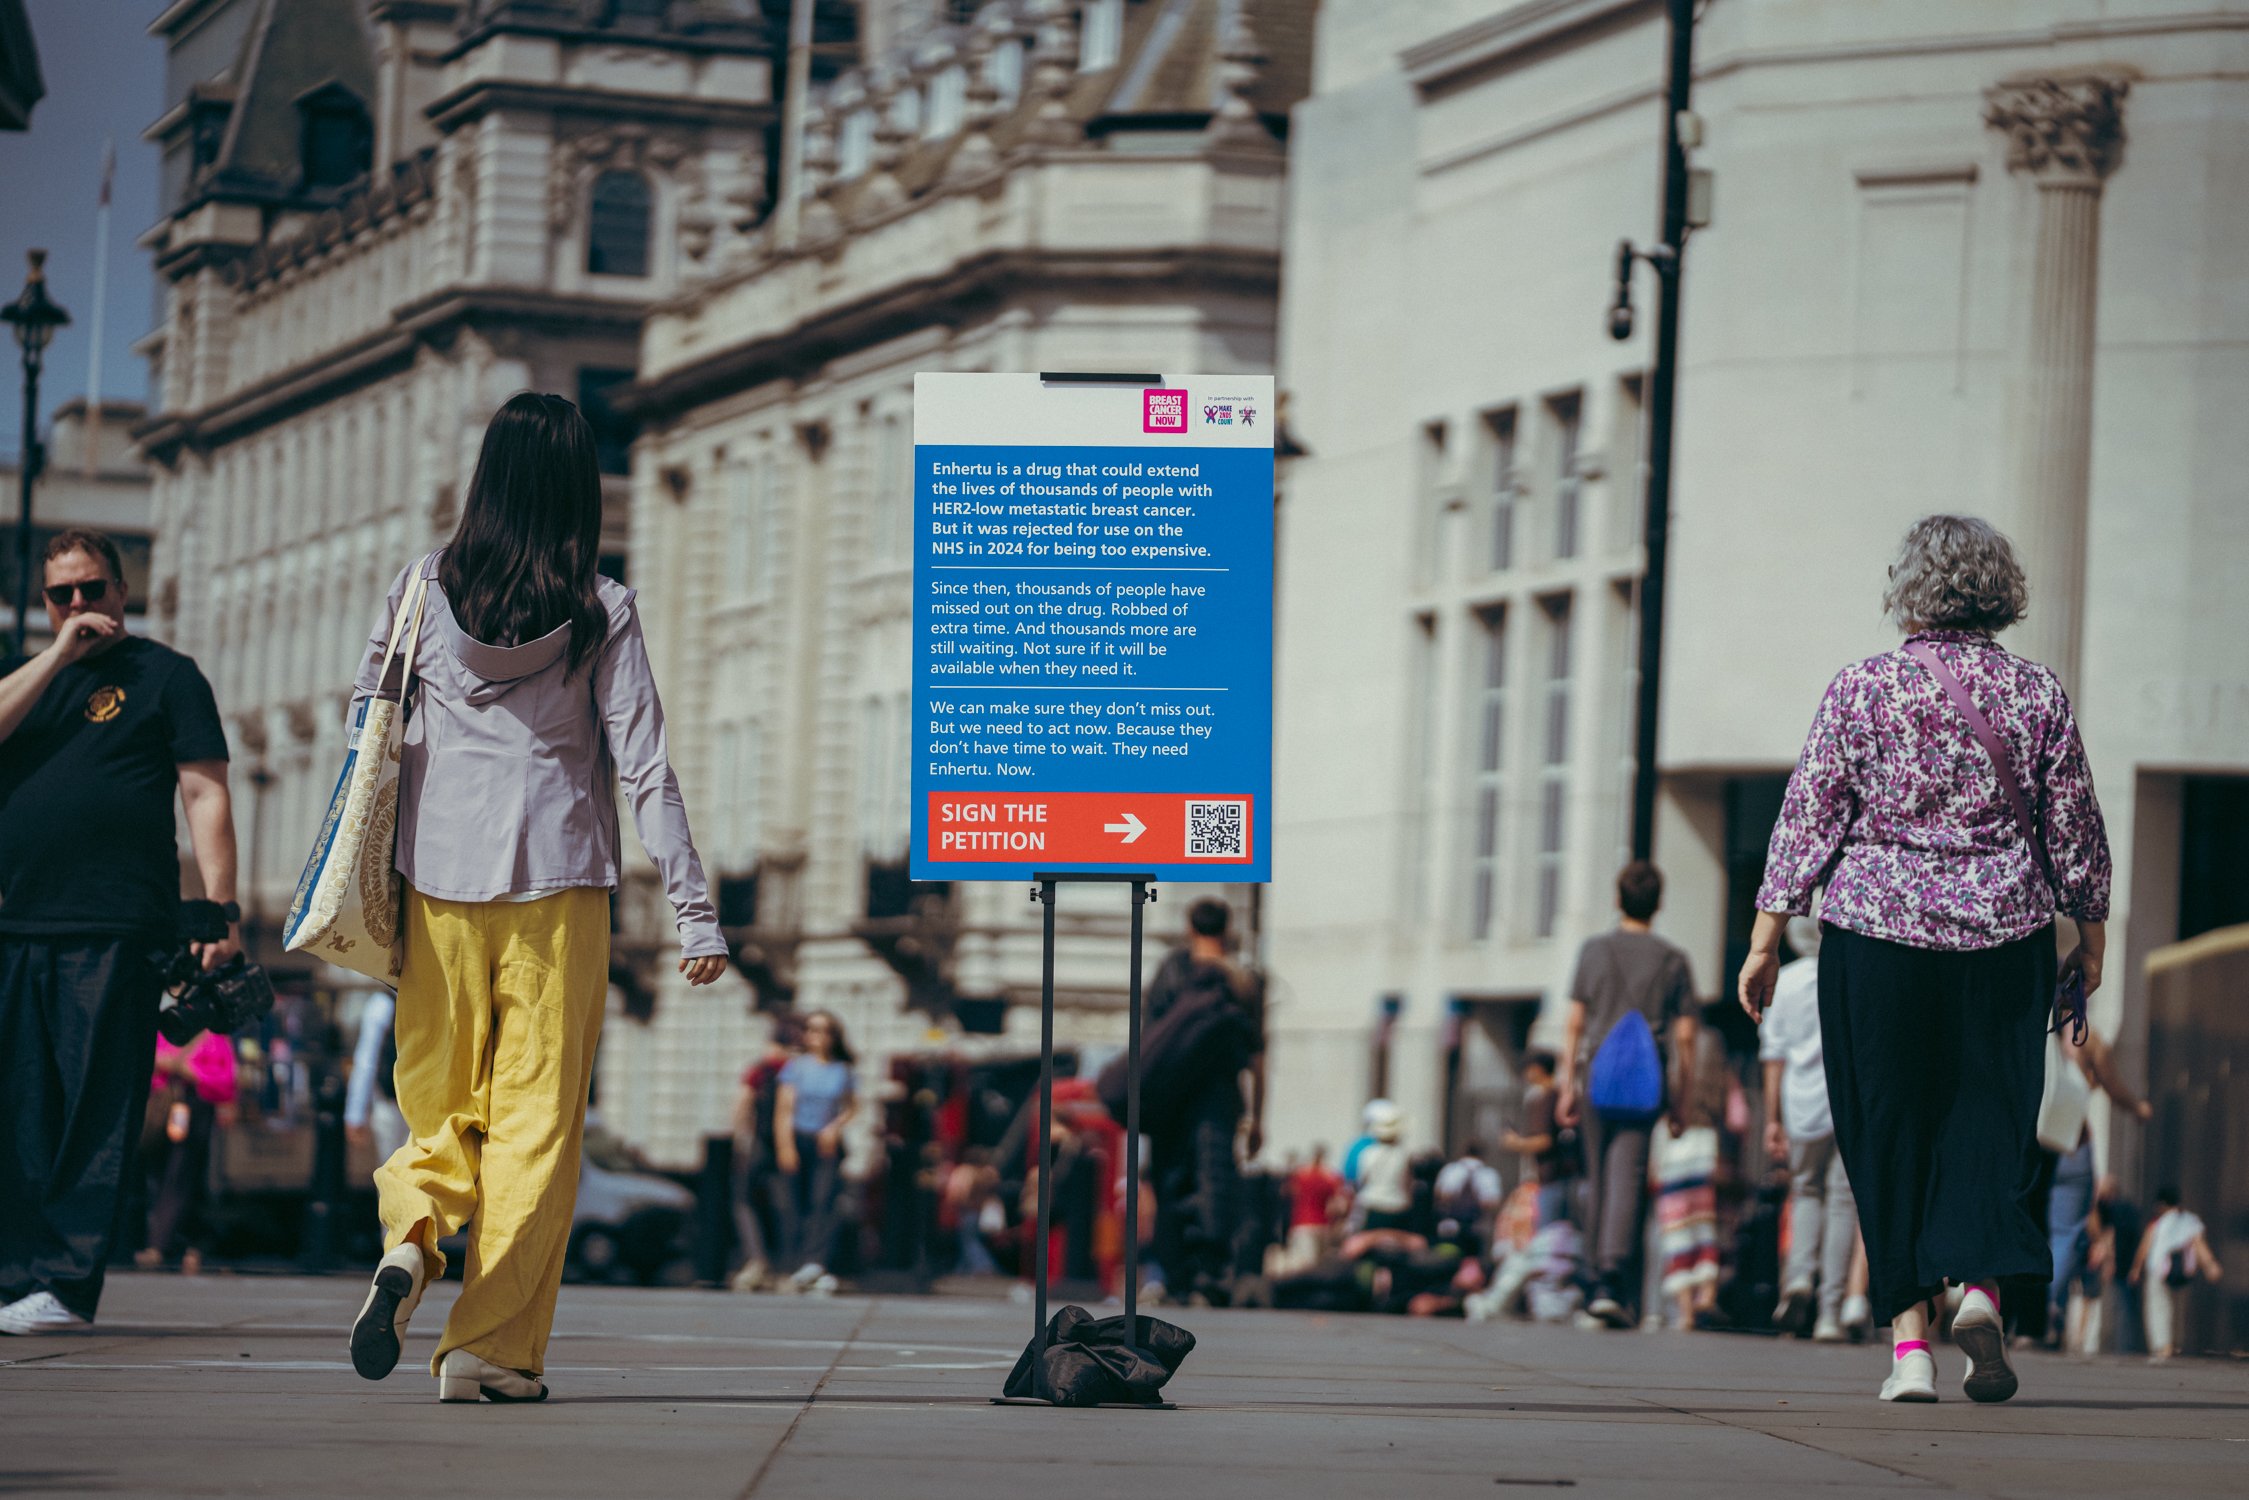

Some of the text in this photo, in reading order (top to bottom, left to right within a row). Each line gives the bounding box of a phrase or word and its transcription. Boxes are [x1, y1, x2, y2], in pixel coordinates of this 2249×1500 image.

[1149, 396, 1182, 405] BREAST
[1149, 405, 1182, 414] CANCER
[1156, 417, 1176, 425] NOW
[934, 462, 1199, 479] Enhertu is a drug that could extend
[932, 482, 1212, 499] the lives of thousands of people with
[933, 502, 1195, 516] HER2-low metastatic breast cancer.
[933, 522, 1183, 538] But it was rejected for use on the
[933, 542, 1210, 559] NHS in 2024 for being too expensive.
[932, 581, 1205, 598] Since then, thousands of people have
[932, 601, 1188, 618] missed out on the drug. Robbed of
[931, 621, 1196, 636] extra time. And thousands more are
[931, 641, 1166, 657] still waiting. Not sure if it will be
[931, 661, 1136, 678] available when they need it.
[930, 701, 1214, 718] We can make sure they don’t miss out.
[931, 721, 1212, 739] But we need to act now. Because they
[930, 741, 1188, 758] don’t have time to wait. They need
[930, 762, 1034, 775] Enhertu. Now.
[941, 803, 1047, 823] SIGN THE
[941, 831, 1045, 849] PETITION
